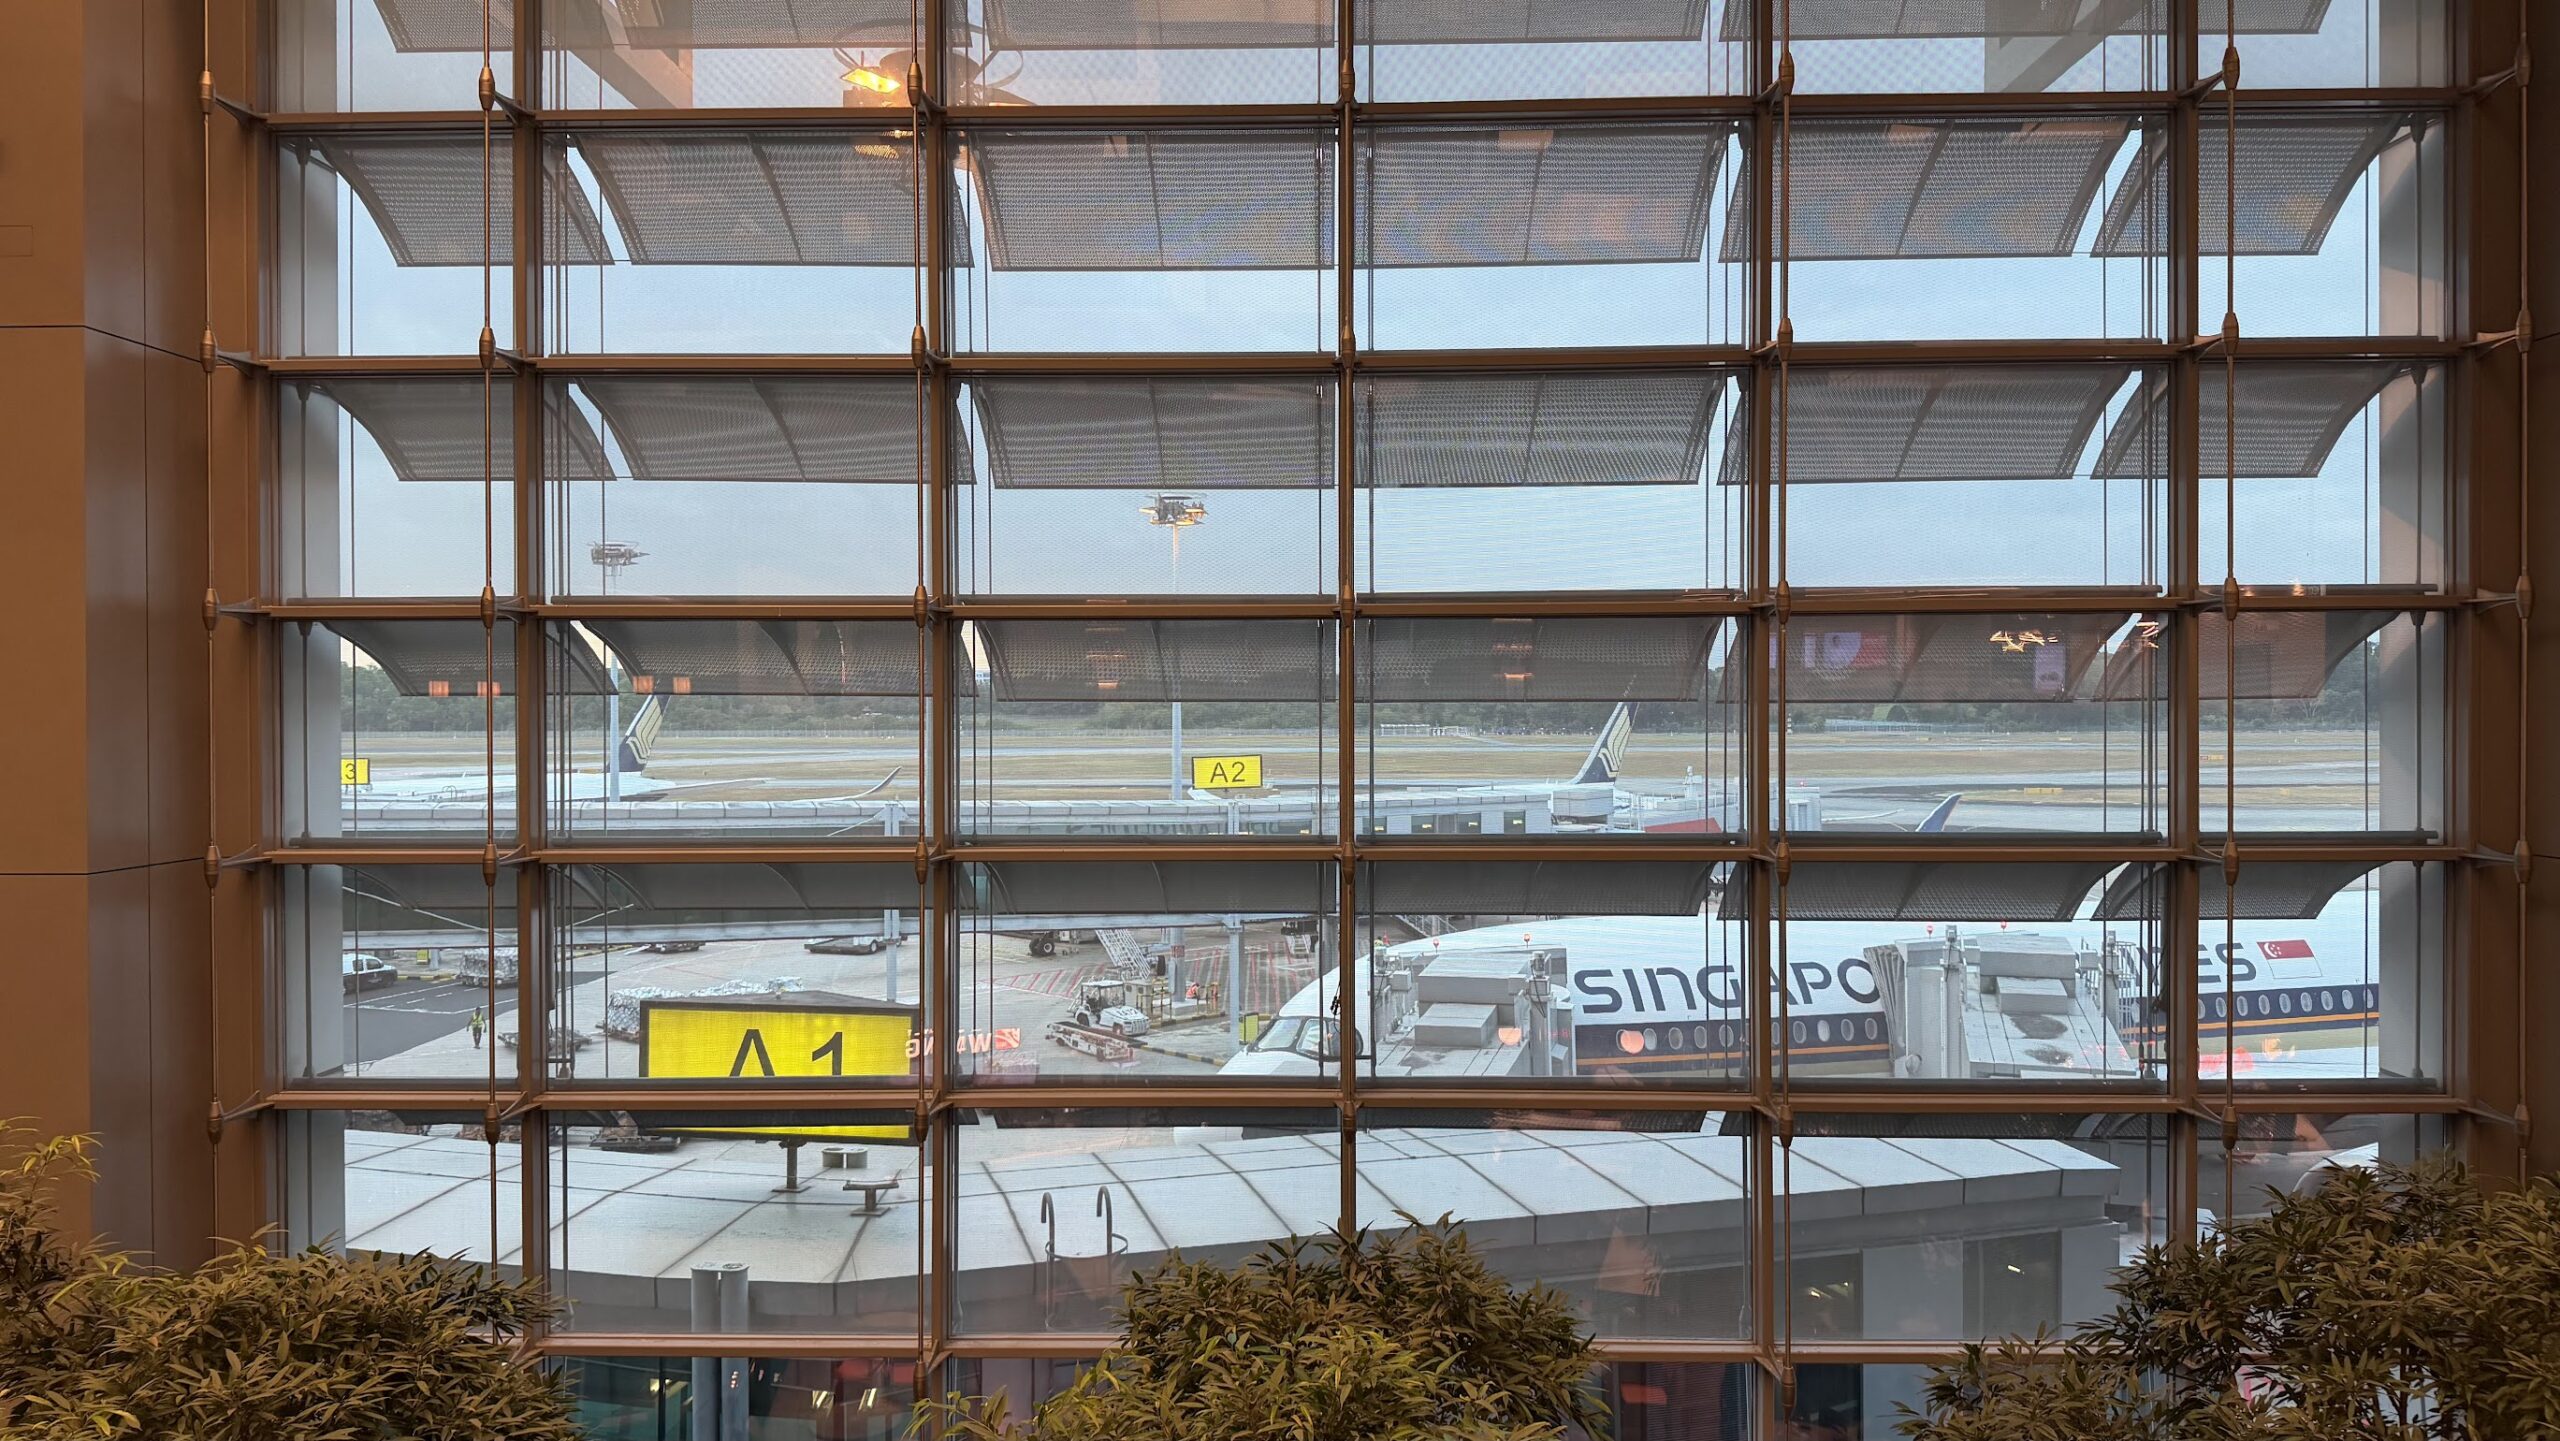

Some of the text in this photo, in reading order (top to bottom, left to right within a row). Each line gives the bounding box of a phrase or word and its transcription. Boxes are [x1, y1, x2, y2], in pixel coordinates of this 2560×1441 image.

[345, 763, 356, 780] 3
[1210, 761, 1246, 783] A2
[1574, 958, 1879, 1014] SINGAPO
